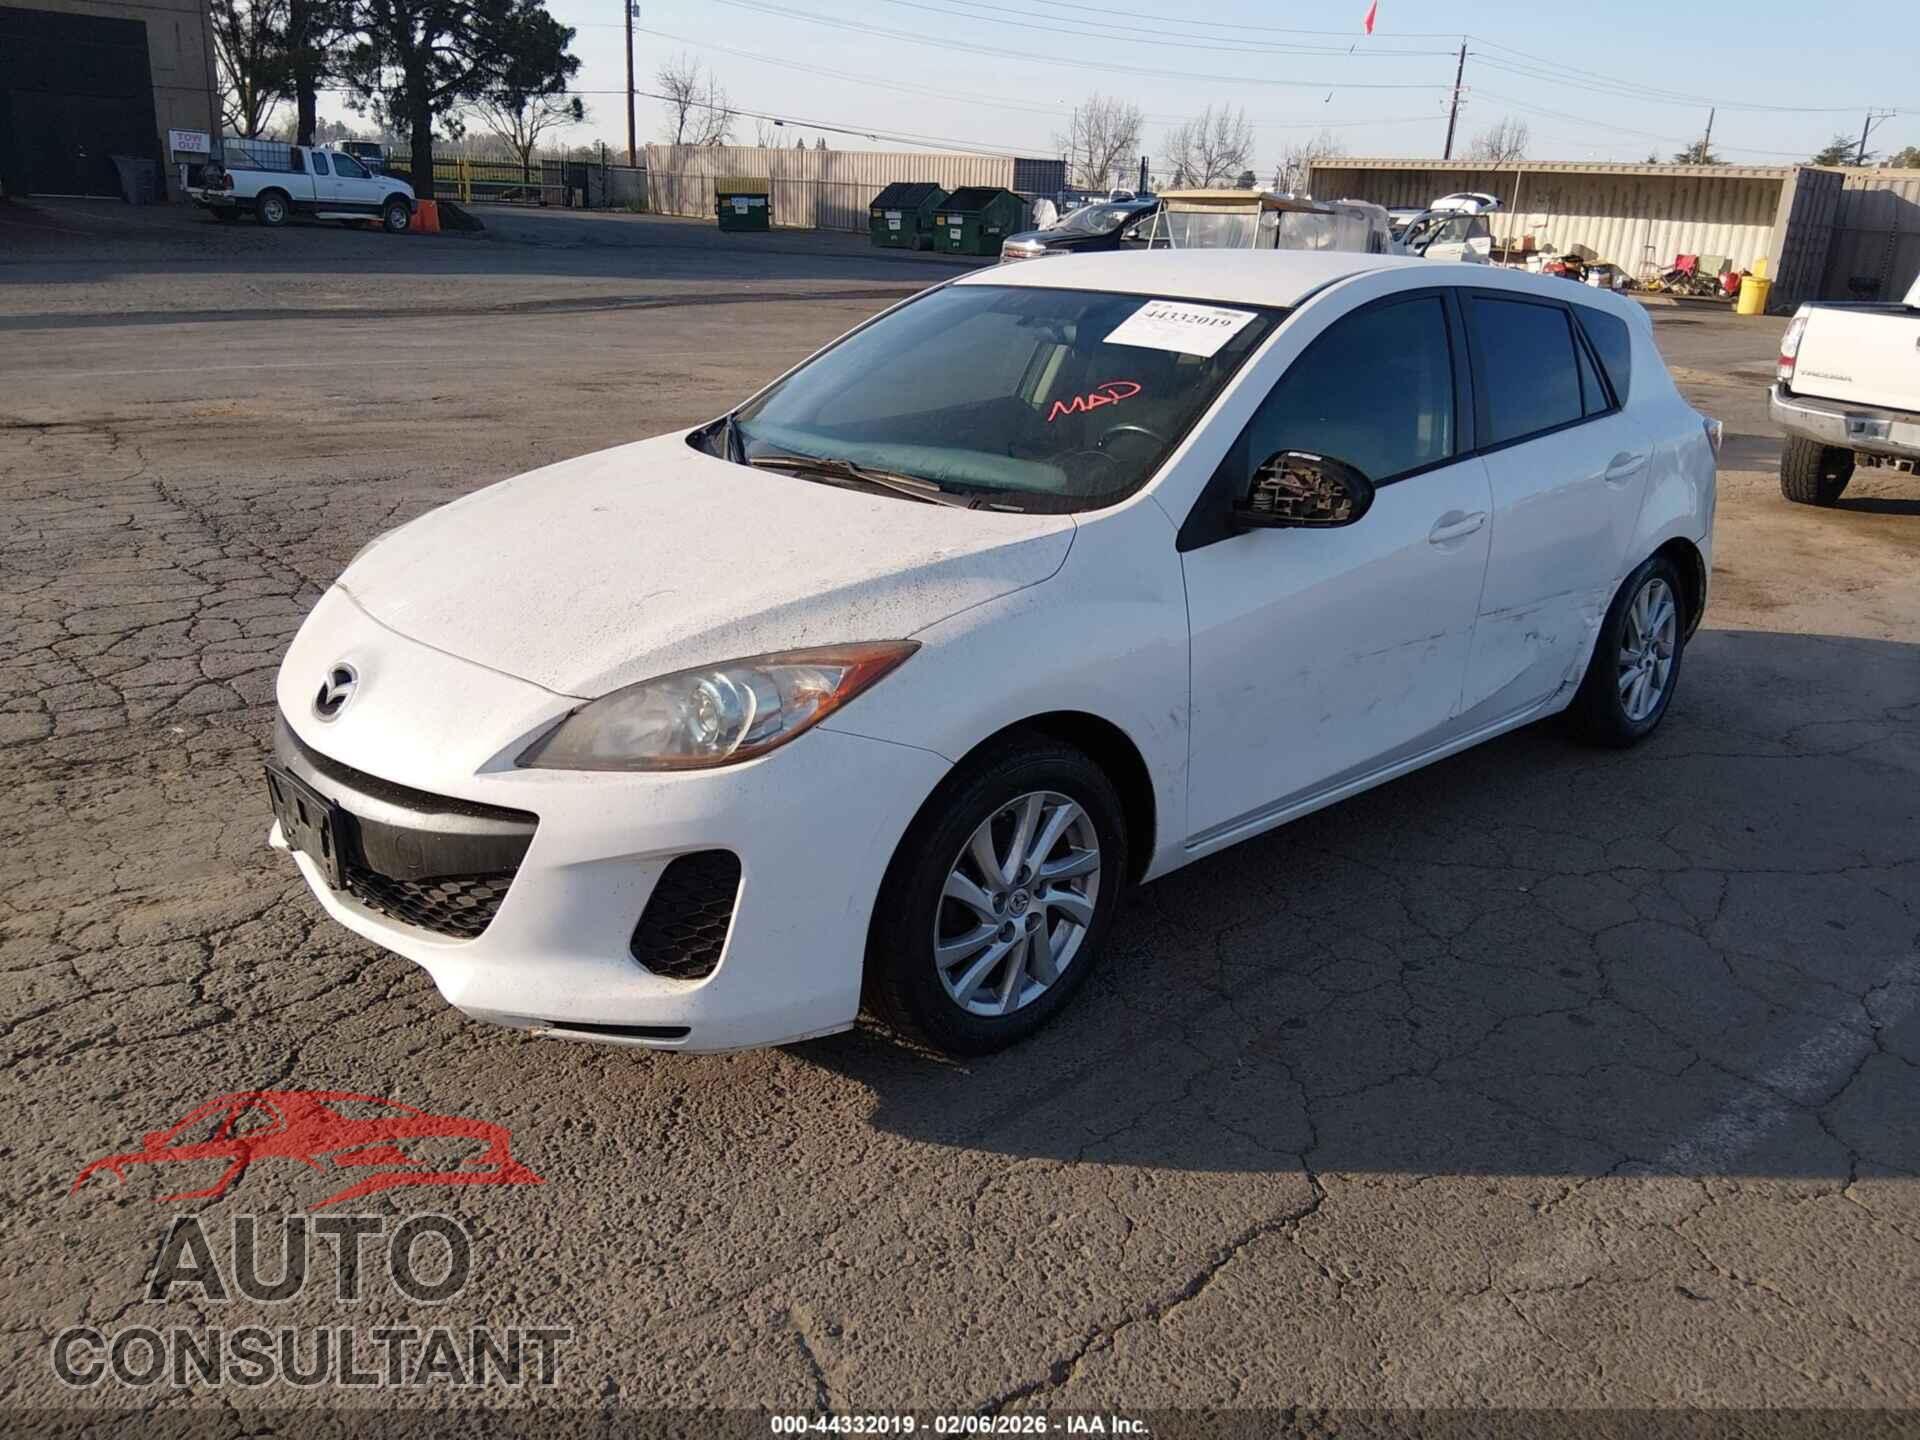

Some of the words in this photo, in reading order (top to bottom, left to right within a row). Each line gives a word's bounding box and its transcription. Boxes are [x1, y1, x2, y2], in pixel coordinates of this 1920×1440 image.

[176, 133, 202, 142] TOW
[178, 141, 201, 151] OUT
[1145, 310, 1232, 327] 44332019
